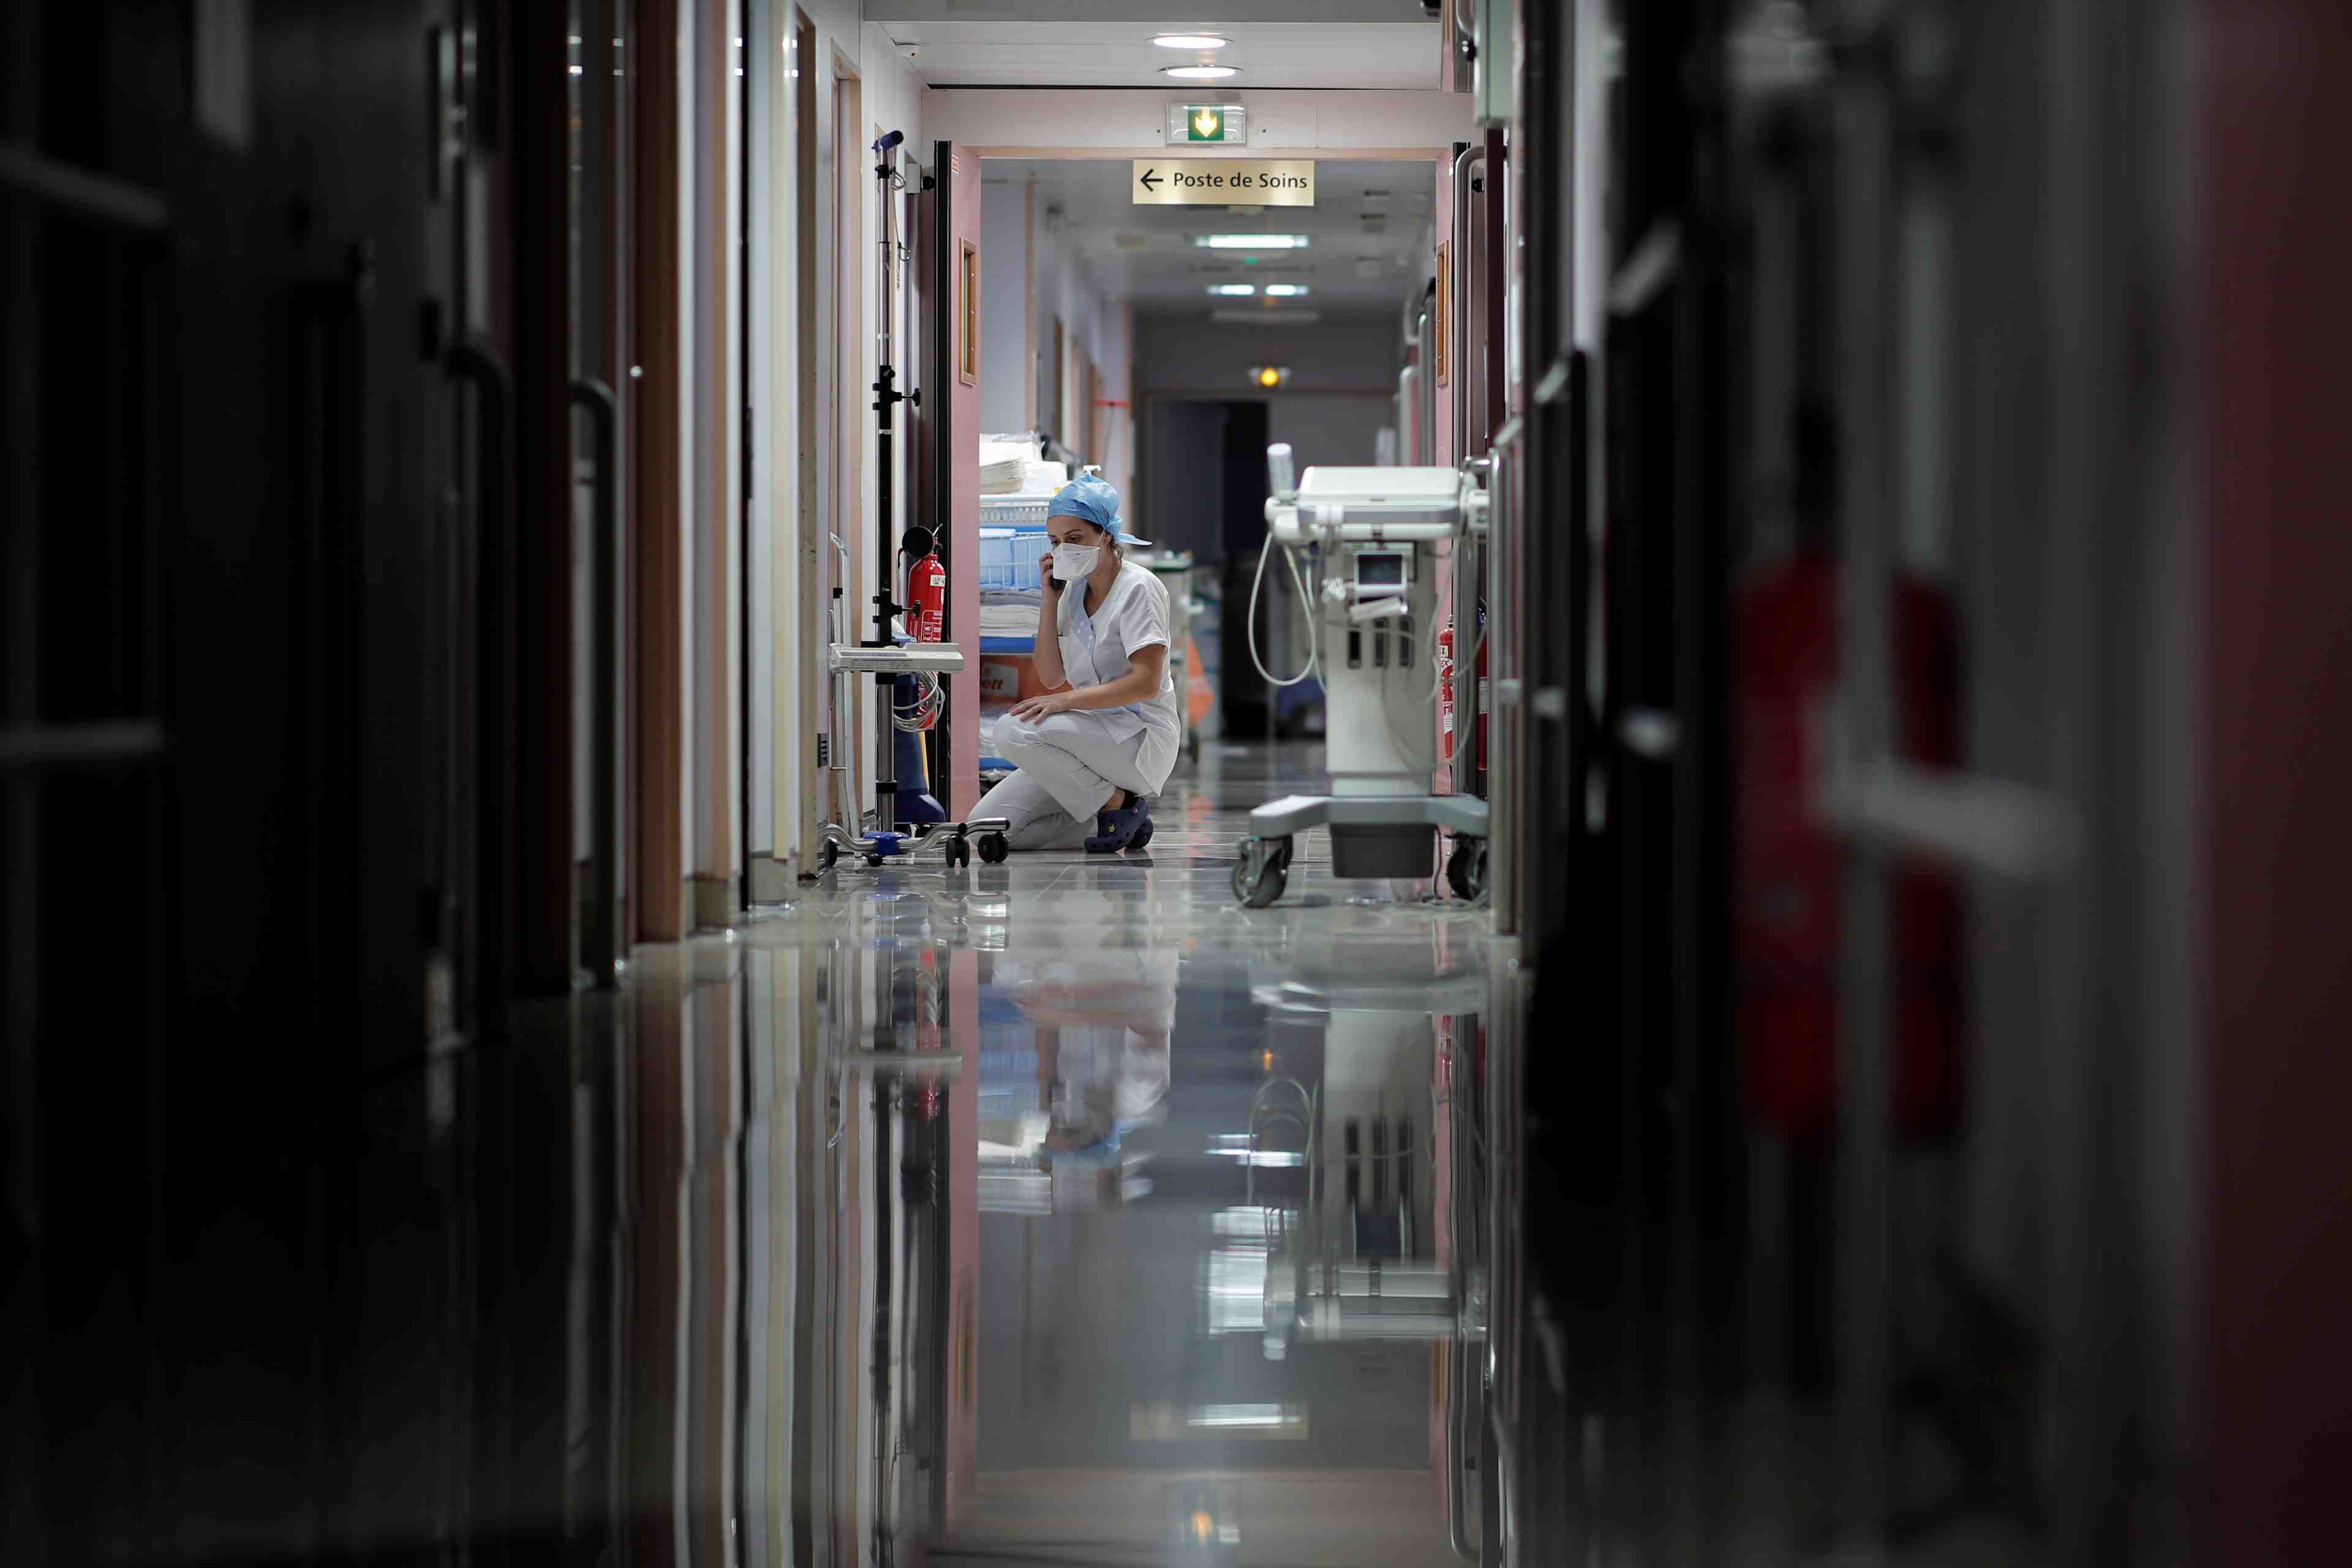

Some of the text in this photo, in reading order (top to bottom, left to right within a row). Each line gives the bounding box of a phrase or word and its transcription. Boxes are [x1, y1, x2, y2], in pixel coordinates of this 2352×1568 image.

[1174, 172, 1307, 188] Poste de Soins
